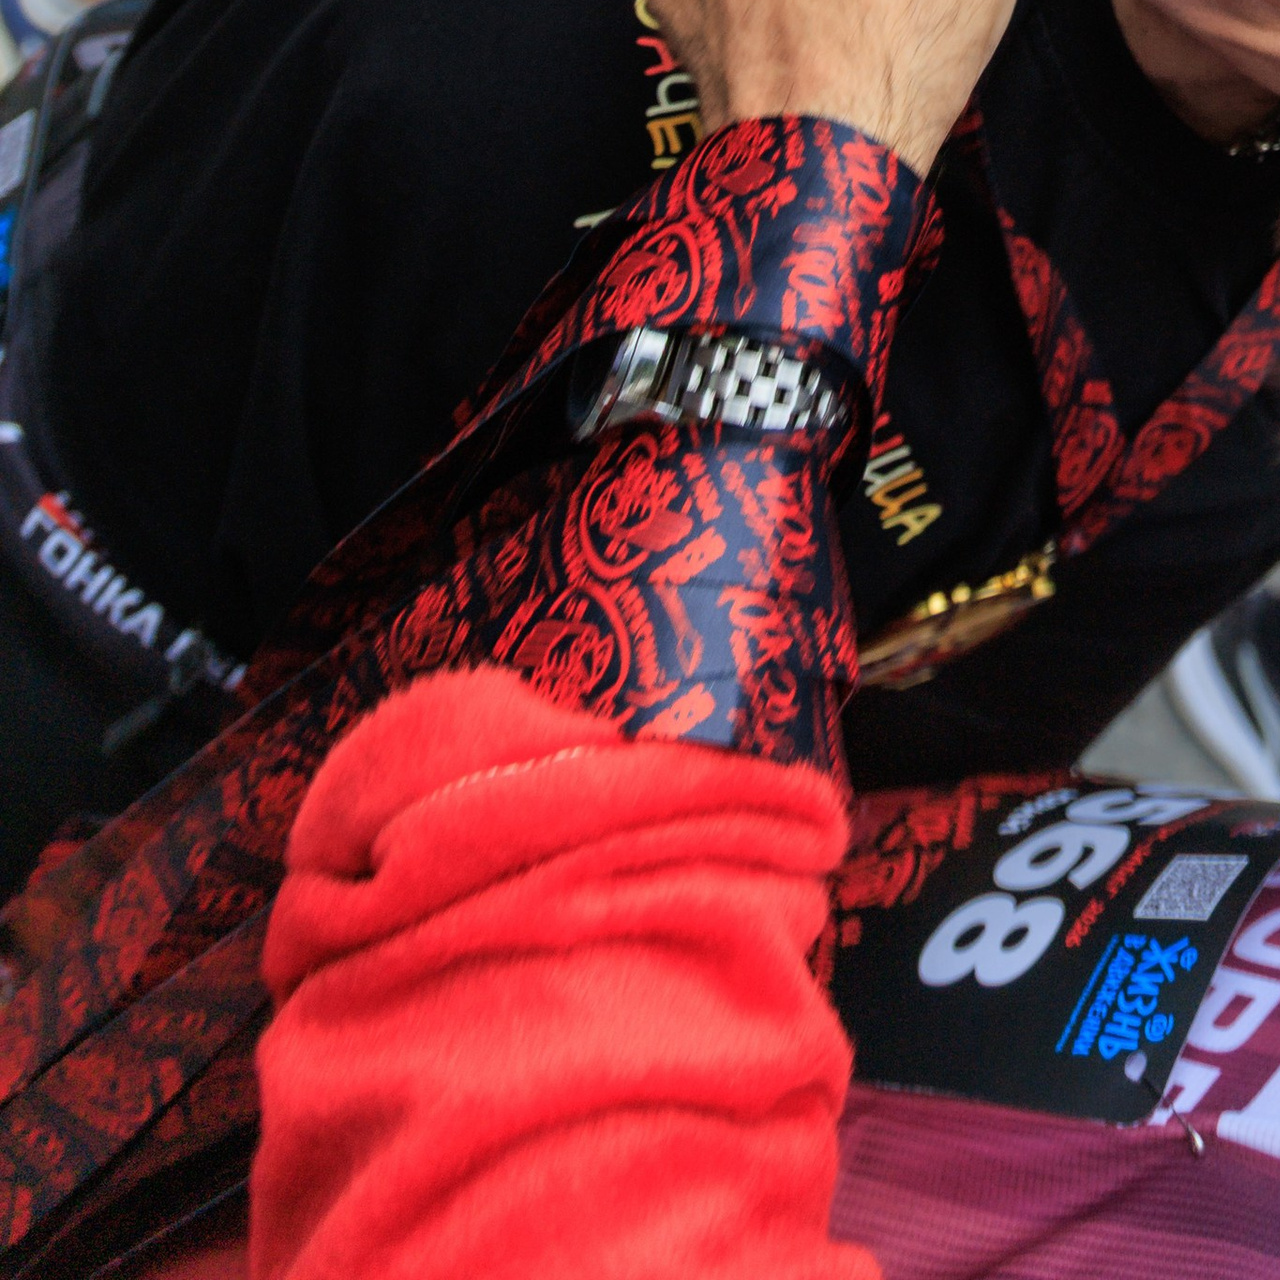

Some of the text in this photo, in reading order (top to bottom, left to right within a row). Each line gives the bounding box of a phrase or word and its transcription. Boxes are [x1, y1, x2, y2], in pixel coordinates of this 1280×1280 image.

[19, 504, 166, 648] ГОНКА
[918, 786, 1213, 986] 568
[1098, 935, 1190, 1061] ЖИЗНЬ
